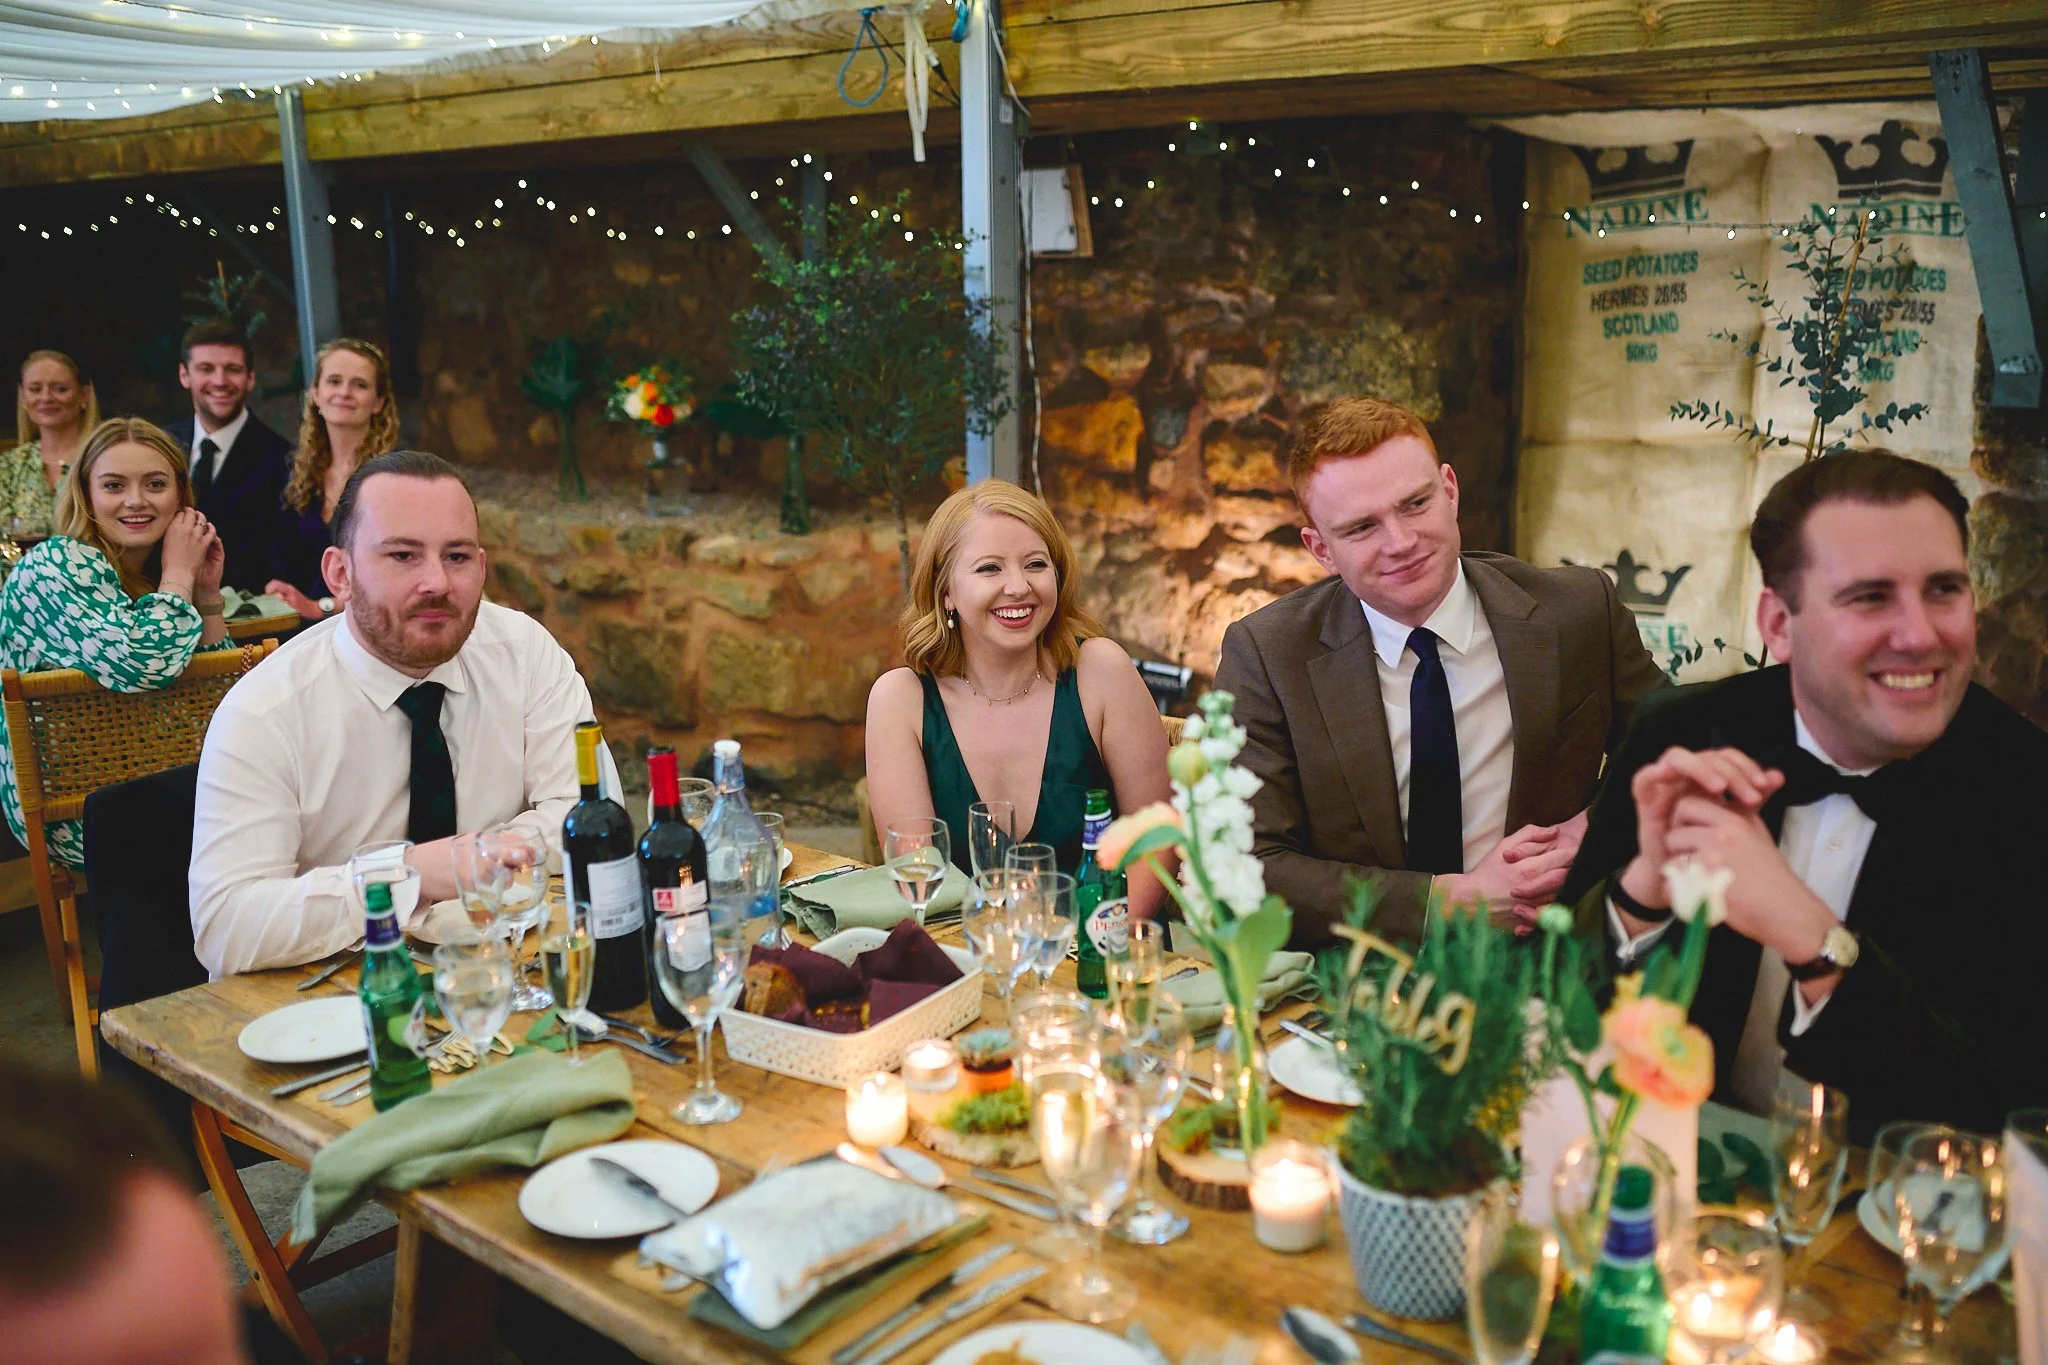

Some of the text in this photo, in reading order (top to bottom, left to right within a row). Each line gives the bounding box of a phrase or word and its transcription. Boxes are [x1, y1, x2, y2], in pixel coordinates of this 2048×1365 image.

[1565, 187, 1709, 238] NADINE
[1584, 251, 1698, 285] SEED POTATOES
[1591, 285, 1649, 313] HERMES
[1603, 311, 1679, 340] SCOTLAND
